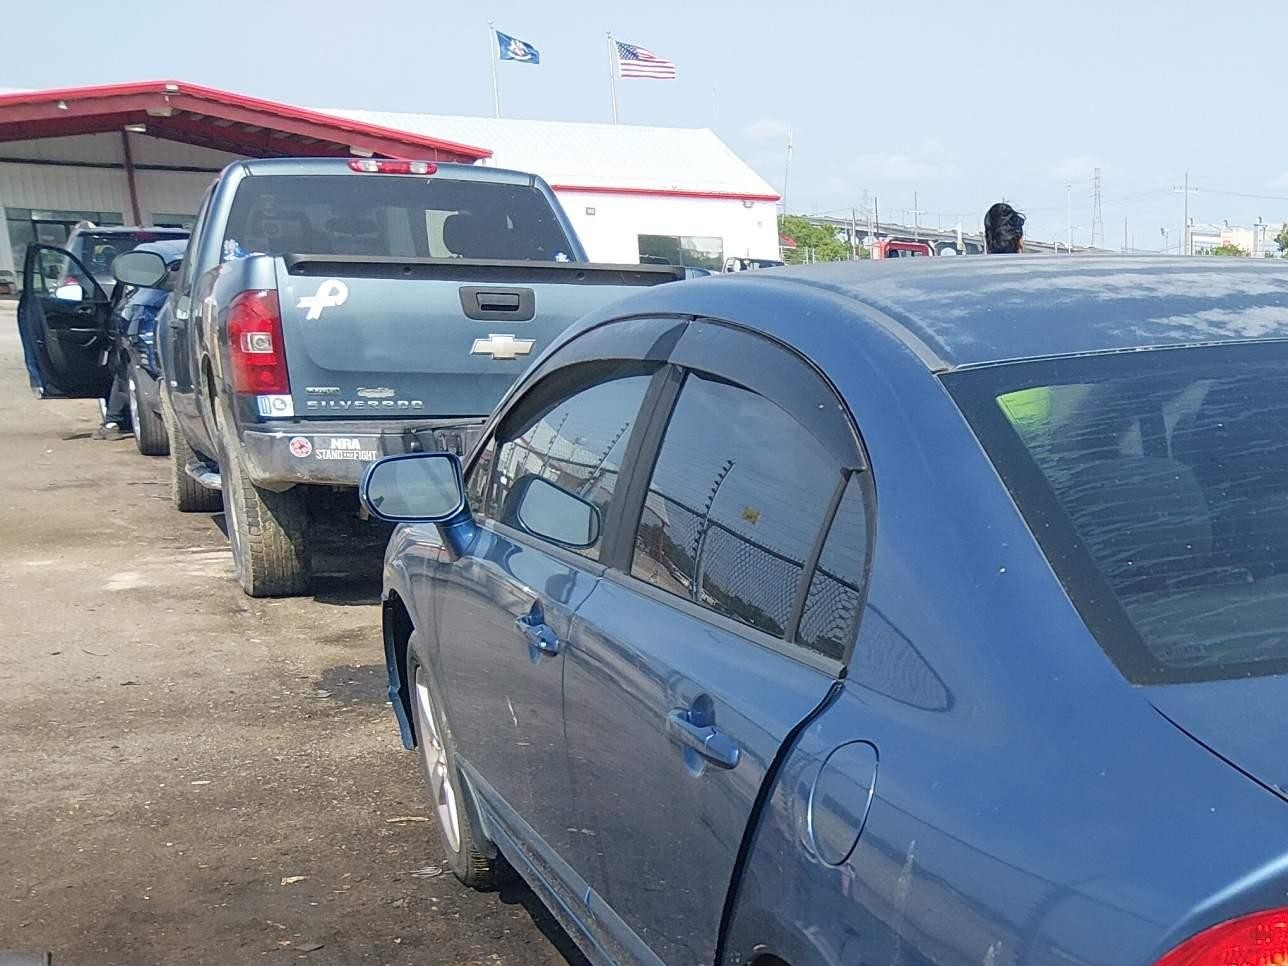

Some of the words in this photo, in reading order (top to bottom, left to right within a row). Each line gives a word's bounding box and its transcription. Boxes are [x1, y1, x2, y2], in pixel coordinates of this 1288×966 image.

[307, 400, 423, 410] SILVERADO
[330, 438, 360, 450] NRA
[315, 449, 343, 460] STAND
[354, 450, 376, 461] FIGHT
